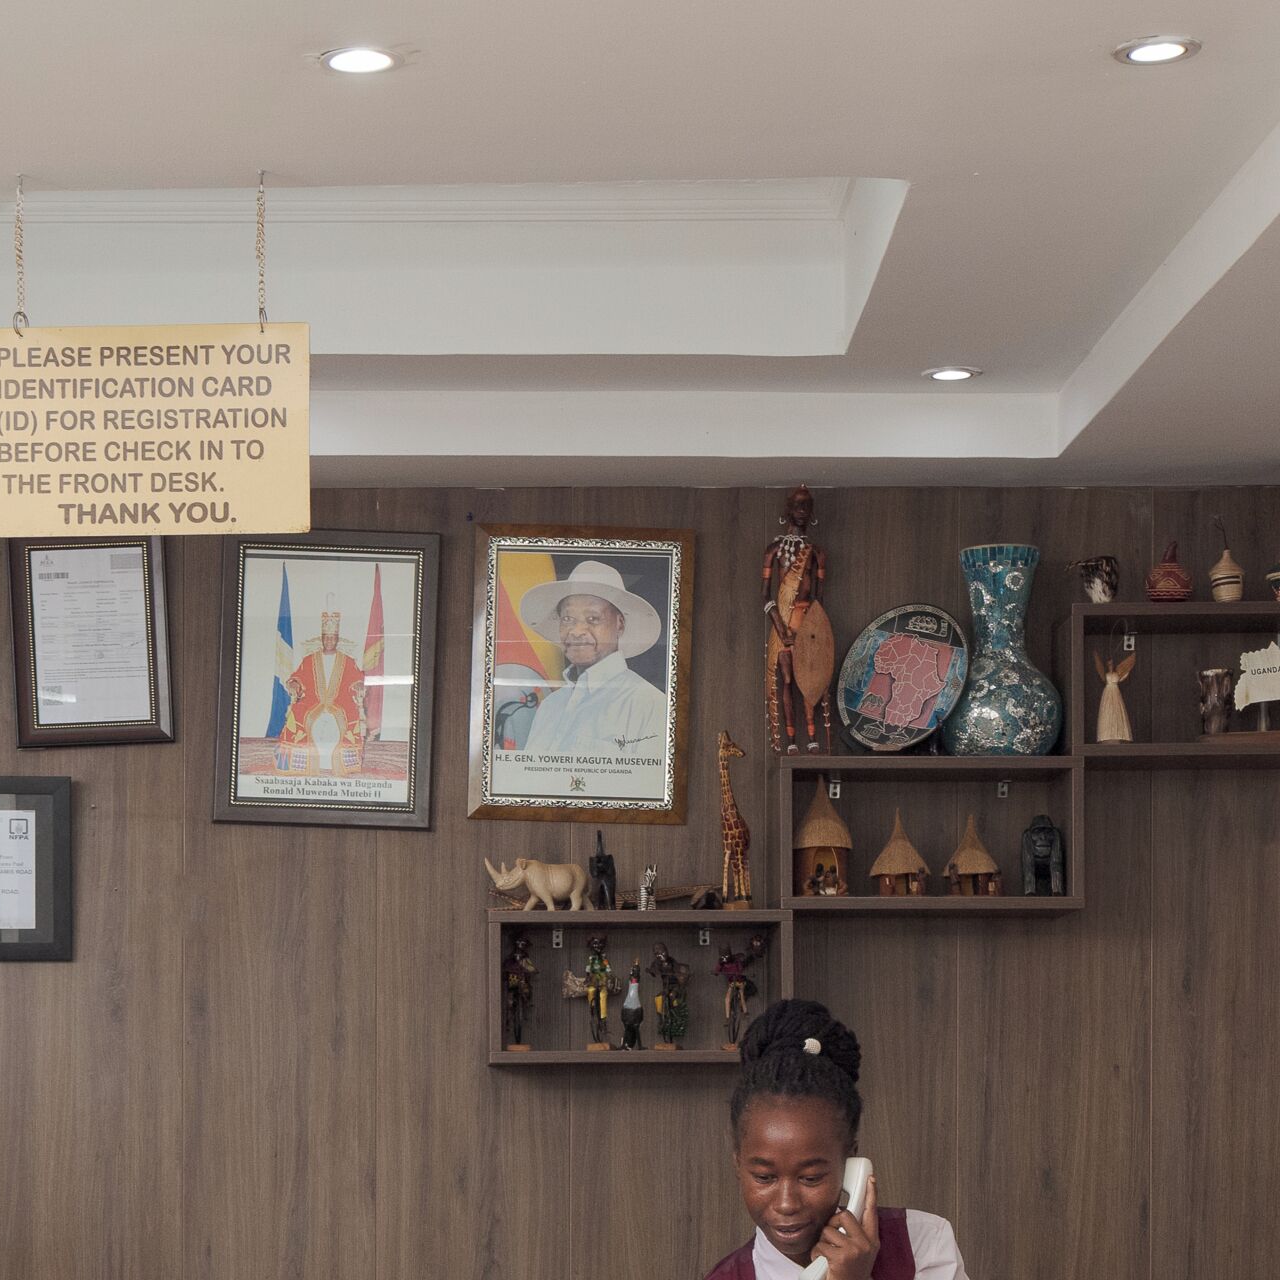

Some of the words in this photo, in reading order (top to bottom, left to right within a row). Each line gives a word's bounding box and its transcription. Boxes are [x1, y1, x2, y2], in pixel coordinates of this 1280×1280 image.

[99, 345, 215, 367] PRESENT
[221, 343, 291, 365] YOUR
[202, 376, 272, 397] CARD
[45, 409, 96, 431] FOR
[103, 407, 288, 430] REGISTRATION
[103, 440, 191, 462] CHECK
[200, 440, 224, 460] IN
[230, 439, 264, 460] TO
[2, 474, 51, 494] THE
[59, 473, 143, 493] FRONT
[151, 472, 224, 492] DESK.
[58, 503, 161, 525] THANK
[168, 502, 237, 524] YOU.
[539, 755, 573, 763] YOWERI
[576, 756, 612, 765] KAGUTA
[615, 758, 662, 766] MUSEVENI
[255, 776, 302, 786] Ssaabasaja
[305, 777, 337, 786] Kabaka
[355, 780, 392, 789] Buganda
[263, 787, 293, 795] Ronald
[296, 788, 338, 796] Muwenda
